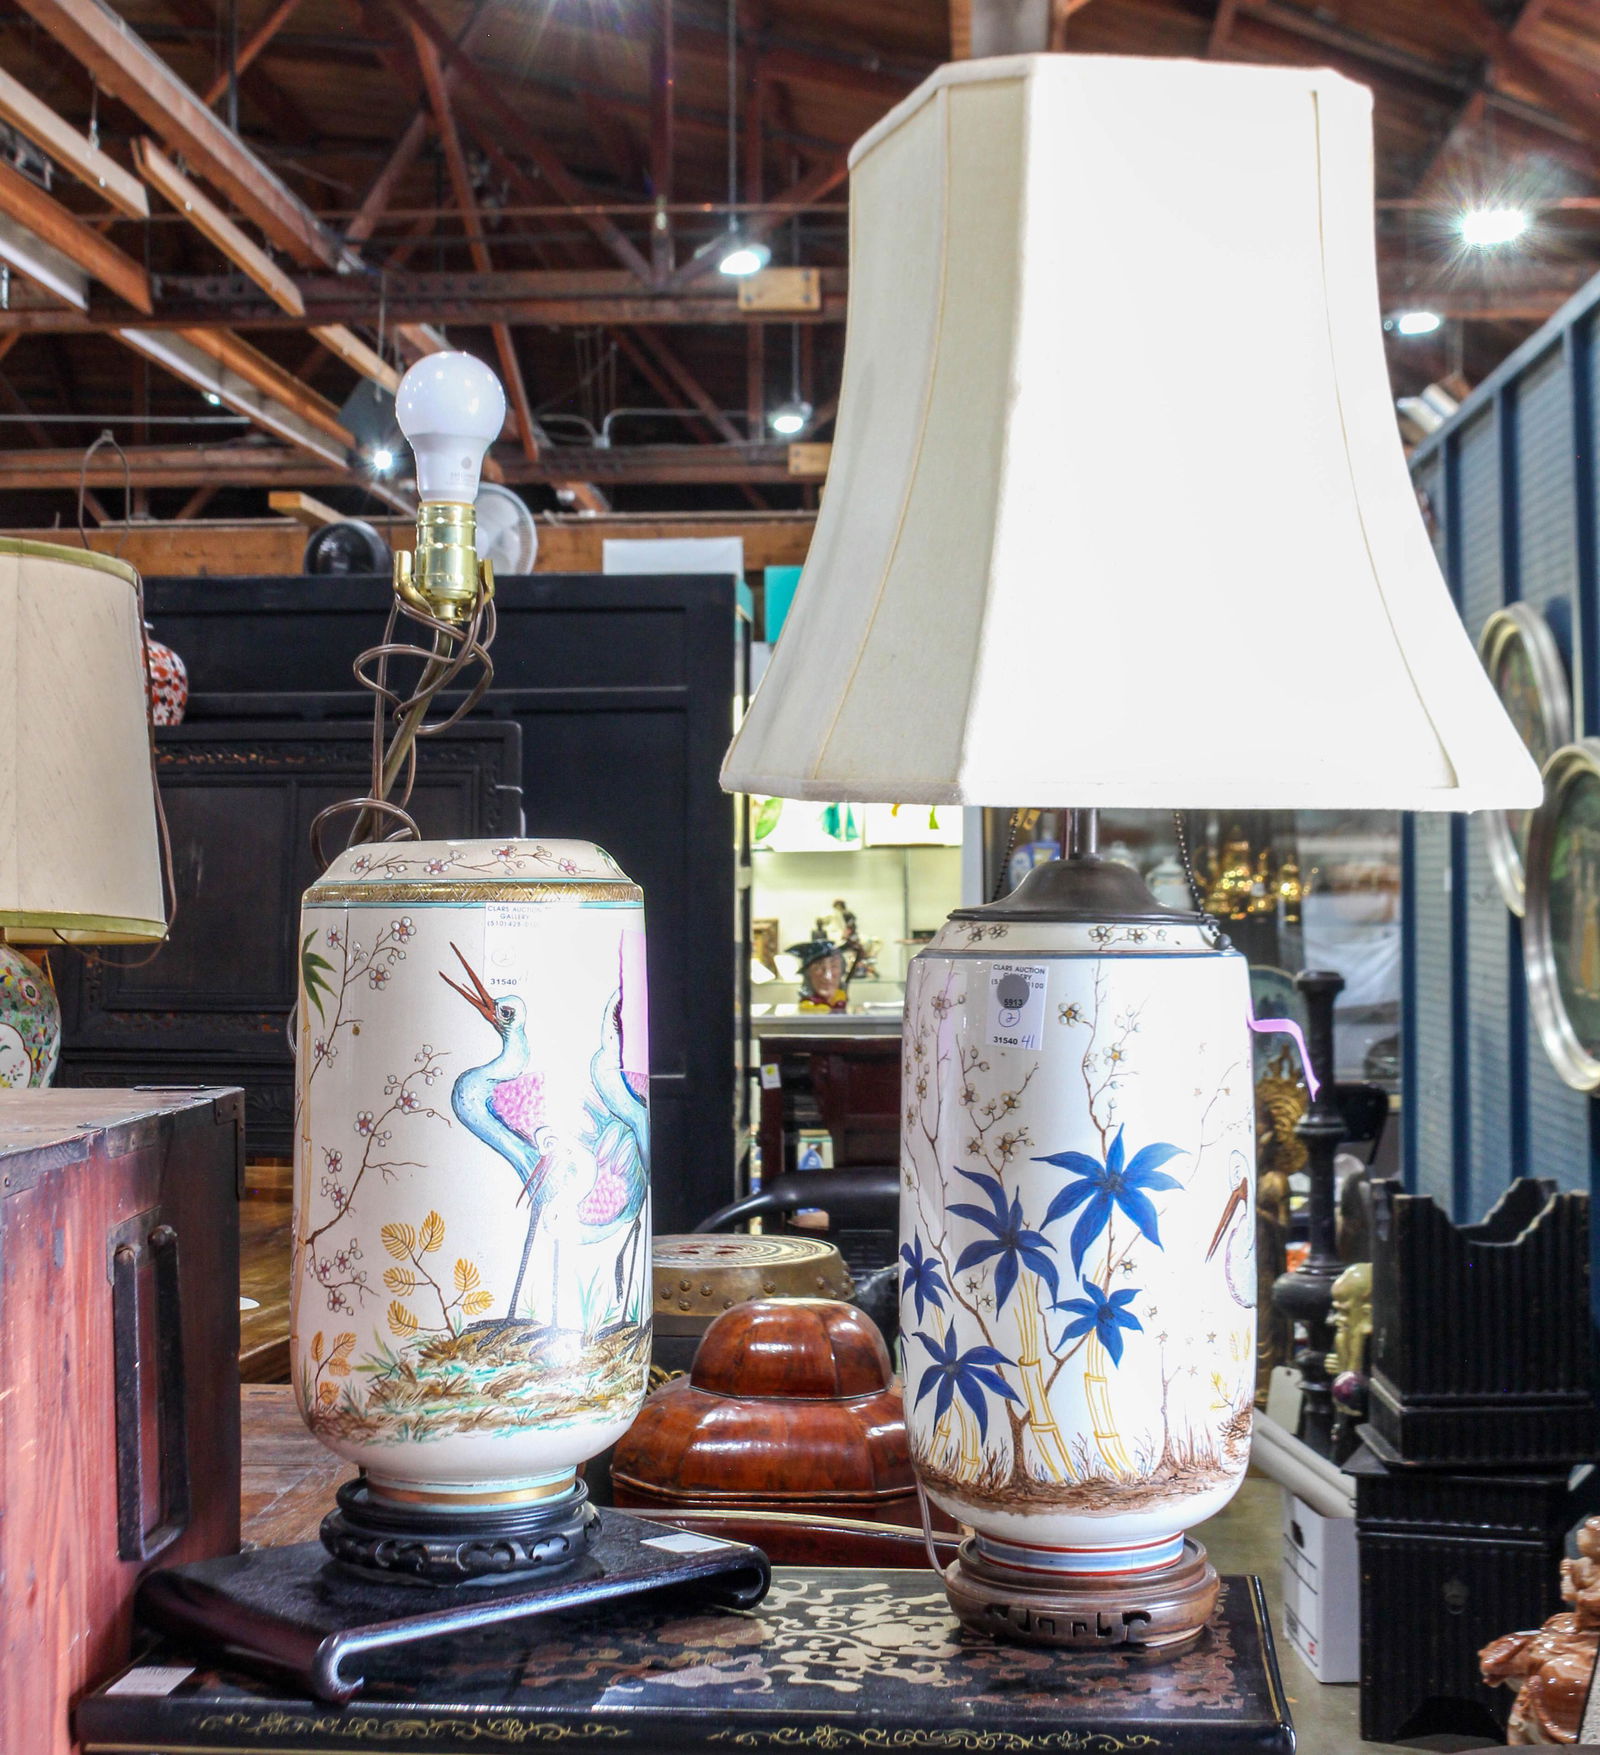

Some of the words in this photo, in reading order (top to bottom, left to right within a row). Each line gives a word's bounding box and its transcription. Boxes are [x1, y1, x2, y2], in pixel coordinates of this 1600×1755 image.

[993, 964, 1012, 972] CLARS
[1015, 966, 1045, 974] AUCTION
[993, 1036, 1018, 1045] 31540
[1021, 1034, 1035, 1050] 41
